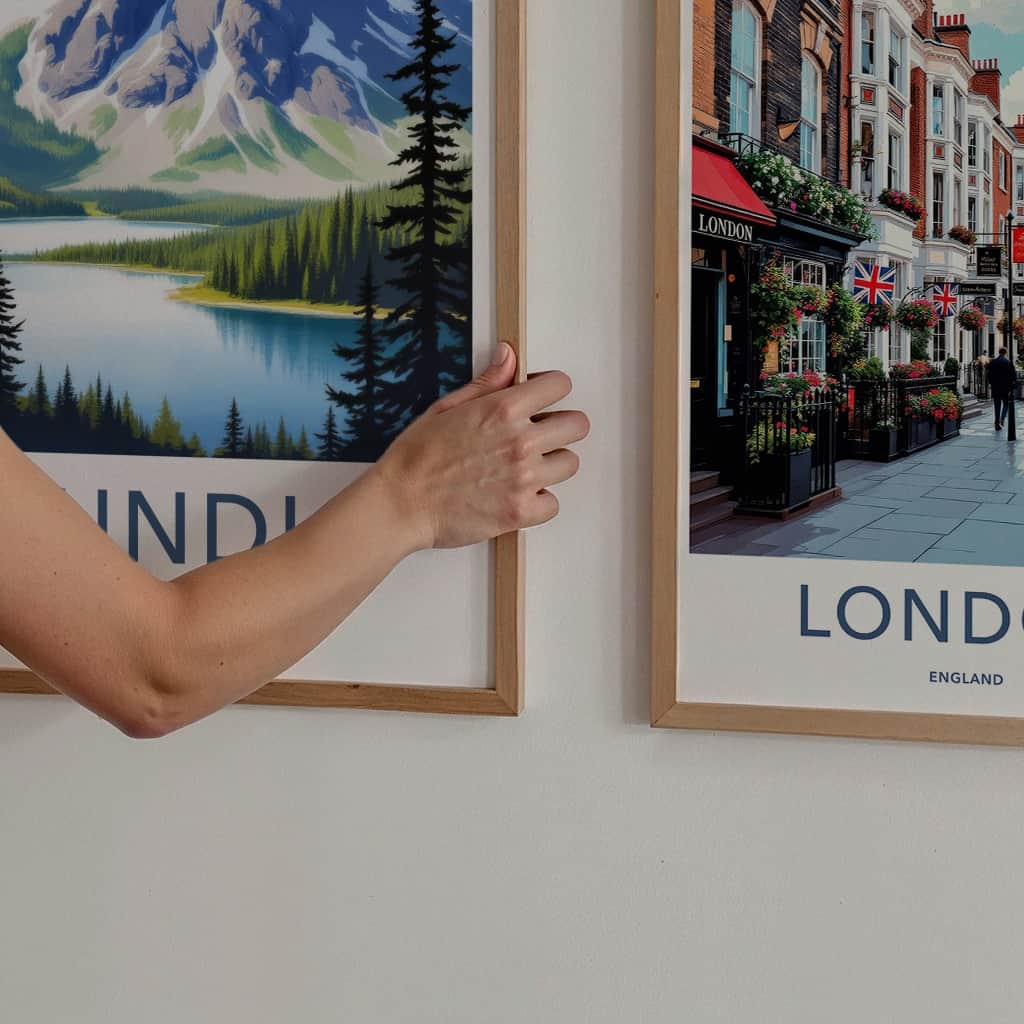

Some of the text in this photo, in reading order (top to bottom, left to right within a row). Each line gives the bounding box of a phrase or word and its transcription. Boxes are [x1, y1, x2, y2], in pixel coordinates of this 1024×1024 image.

[698, 213, 753, 242] LONDON
[800, 583, 1024, 645] LOND
[929, 670, 1004, 686] ENGLAND
